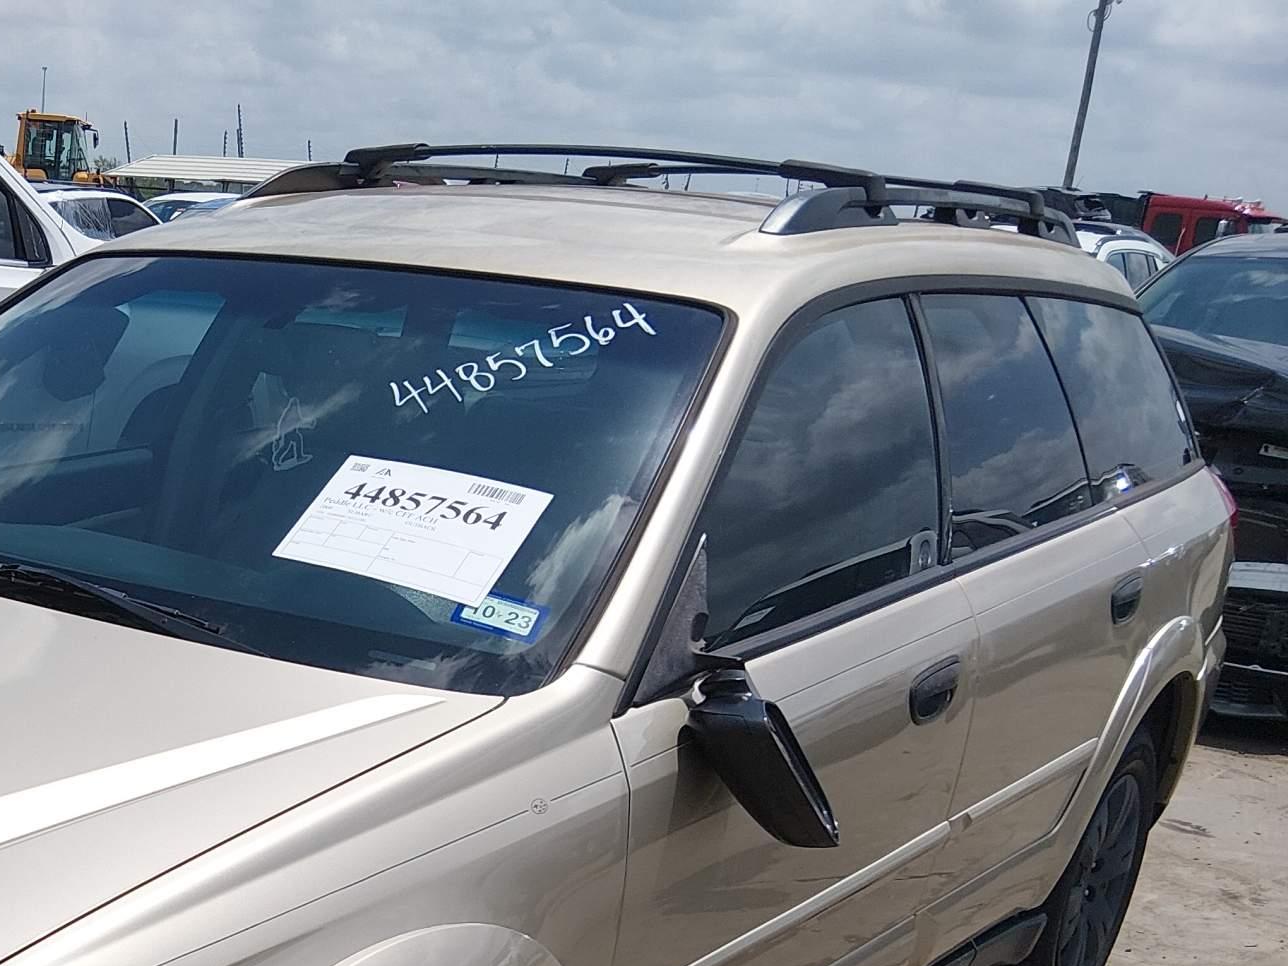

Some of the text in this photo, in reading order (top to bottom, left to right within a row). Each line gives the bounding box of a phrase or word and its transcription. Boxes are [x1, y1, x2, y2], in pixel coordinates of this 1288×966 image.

[389, 302, 657, 414] 44857564
[344, 483, 508, 530] 44857564
[504, 611, 532, 630] 23
